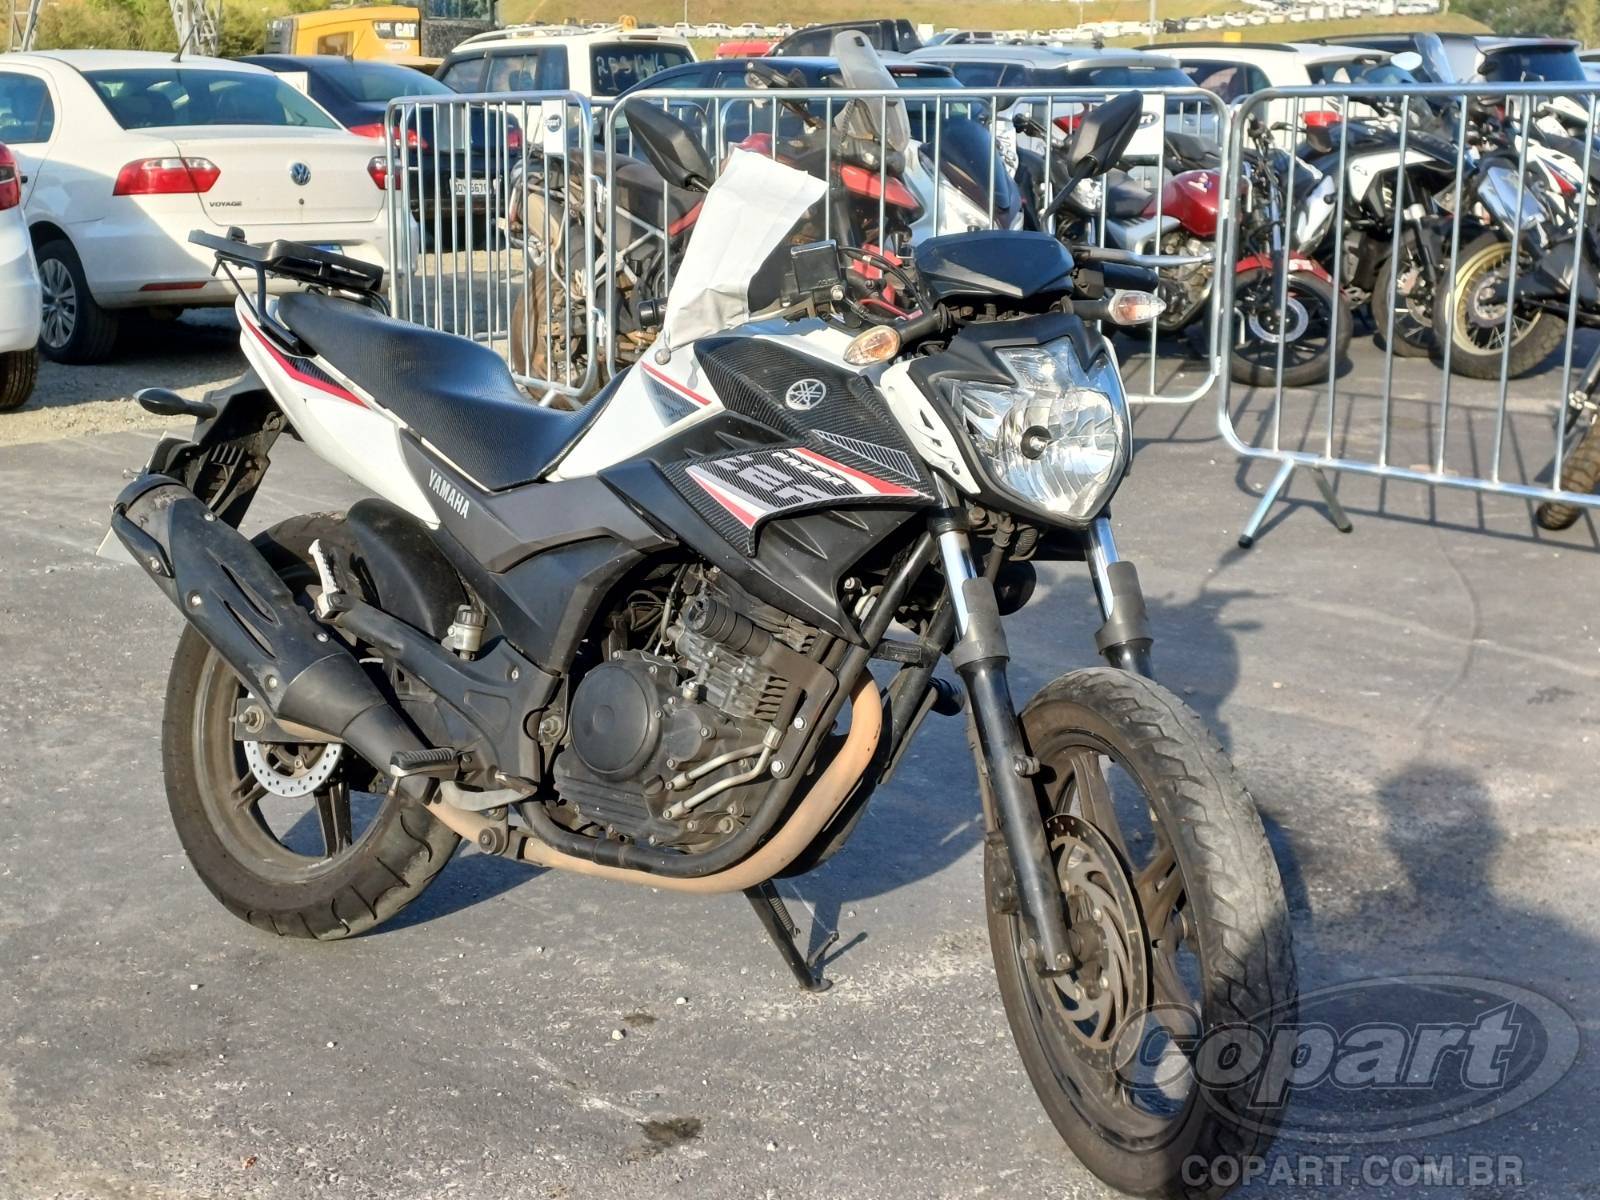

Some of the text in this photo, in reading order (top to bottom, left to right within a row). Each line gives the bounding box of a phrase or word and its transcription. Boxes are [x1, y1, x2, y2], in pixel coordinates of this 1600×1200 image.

[394, 22, 417, 38] CAT
[209, 200, 243, 208] VOYAGE
[428, 468, 470, 519] YAMAHA
